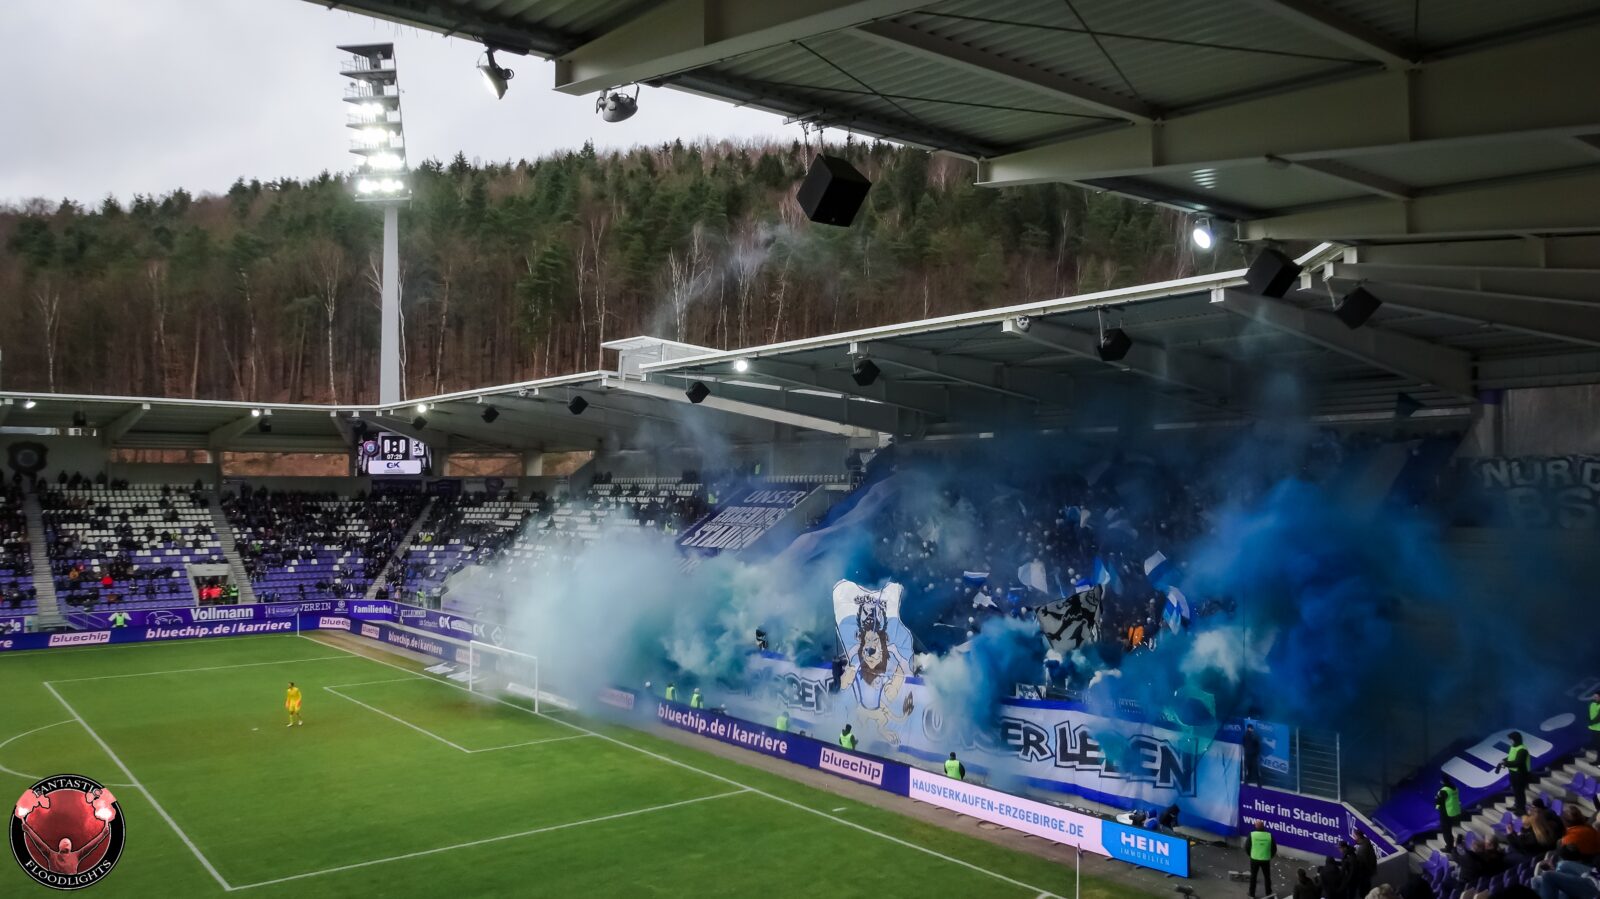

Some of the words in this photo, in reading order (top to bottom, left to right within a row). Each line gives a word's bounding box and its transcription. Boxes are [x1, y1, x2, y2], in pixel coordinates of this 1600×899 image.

[743, 490, 808, 504] UNSER
[190, 607, 254, 621] Vollmann
[52, 632, 109, 643] bluechip
[822, 752, 881, 779] bluechip
[911, 777, 1085, 838] HAUSVERKAUFEN-ERZGEBIRGE.DE
[1254, 799, 1275, 814] hier
[1277, 803, 1291, 818] im
[1292, 807, 1340, 829] Stadion!
[1120, 831, 1170, 857] HEIN
[1120, 847, 1171, 866] IMMOBILIEN
